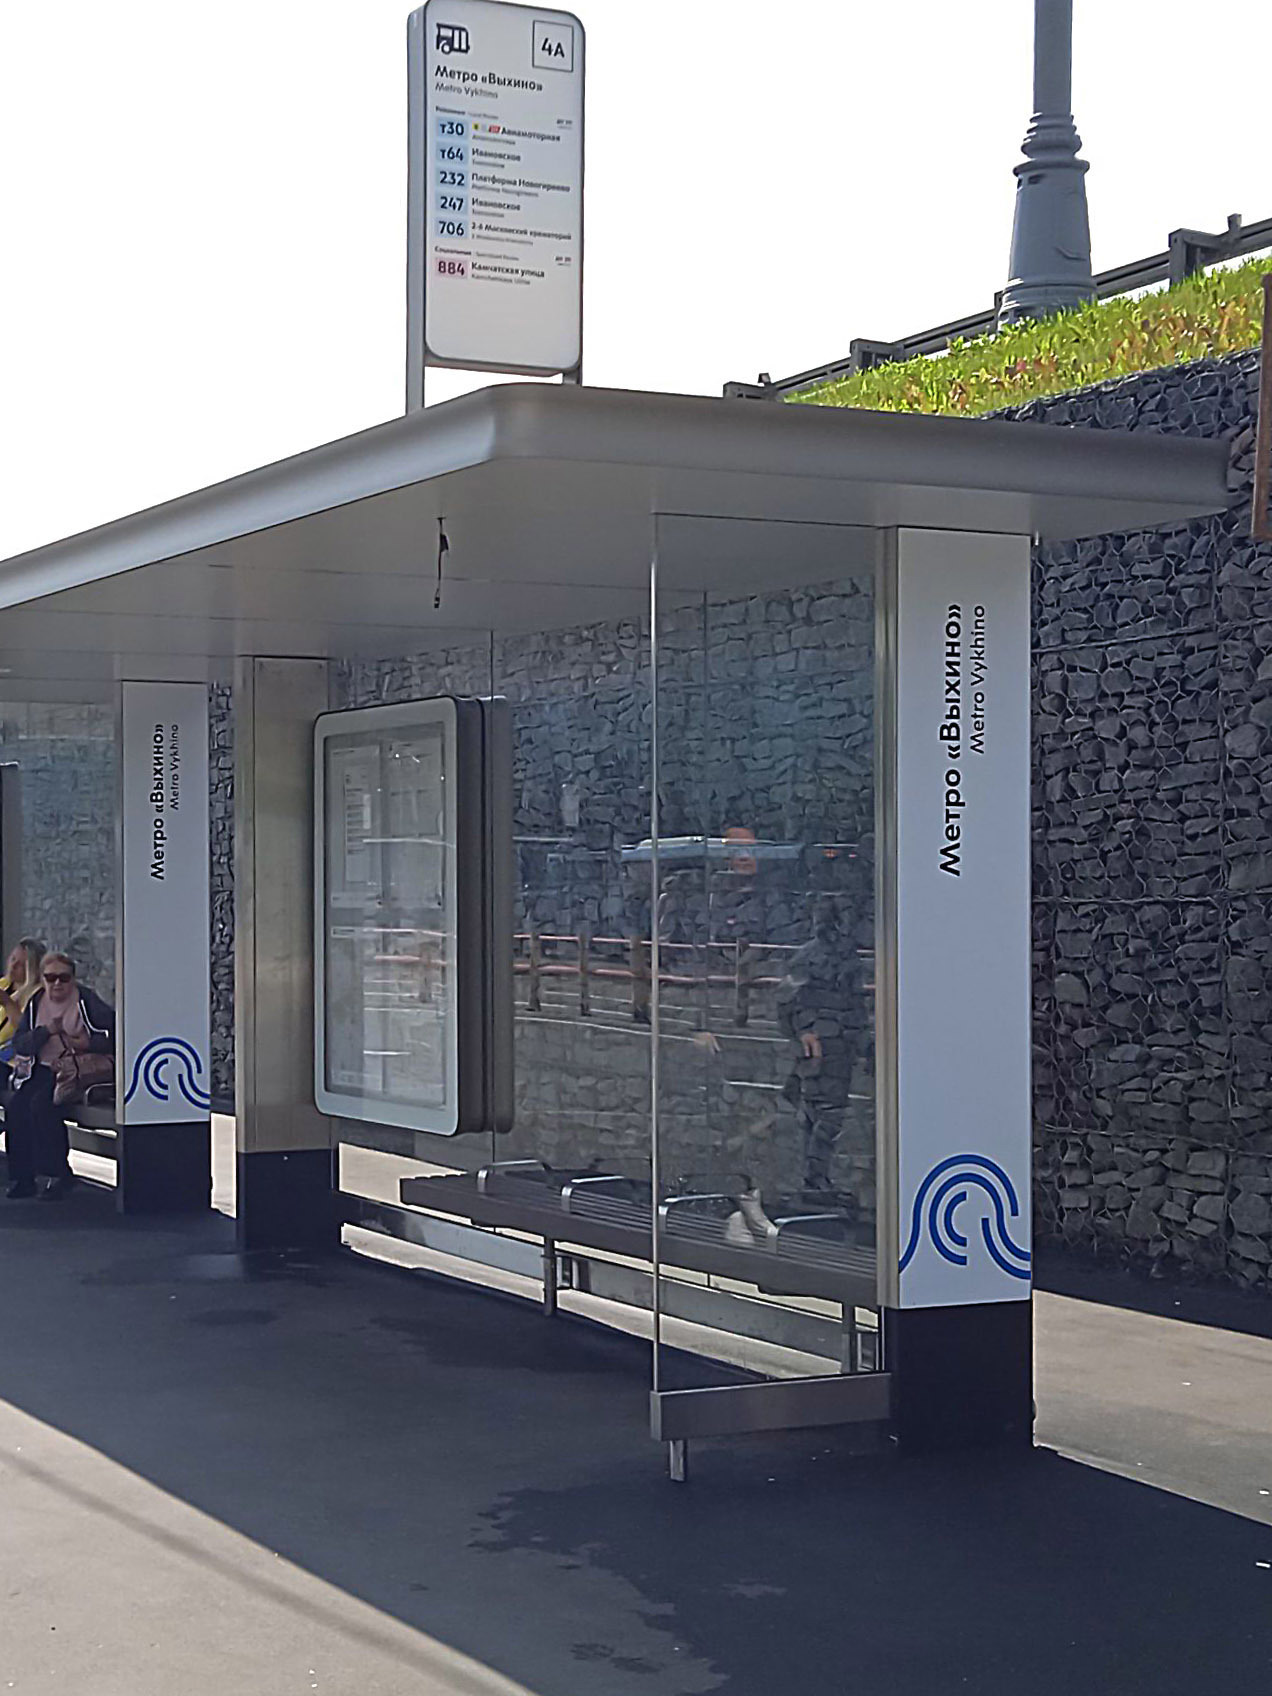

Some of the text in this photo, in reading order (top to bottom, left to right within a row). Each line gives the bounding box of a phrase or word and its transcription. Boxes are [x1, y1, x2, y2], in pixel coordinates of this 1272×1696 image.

[435, 65, 543, 91] Метро «Выхино»
[435, 82, 463, 94] Metro
[439, 171, 465, 186] 232
[440, 196, 464, 211] 247
[439, 220, 465, 236] 706
[438, 260, 465, 276] 884
[969, 604, 988, 754] Metro Vykhino
[939, 603, 966, 877] Метро «Выхино»
[170, 724, 181, 810] Metro Vykhino
[149, 723, 167, 880] Метро «Выхино»
